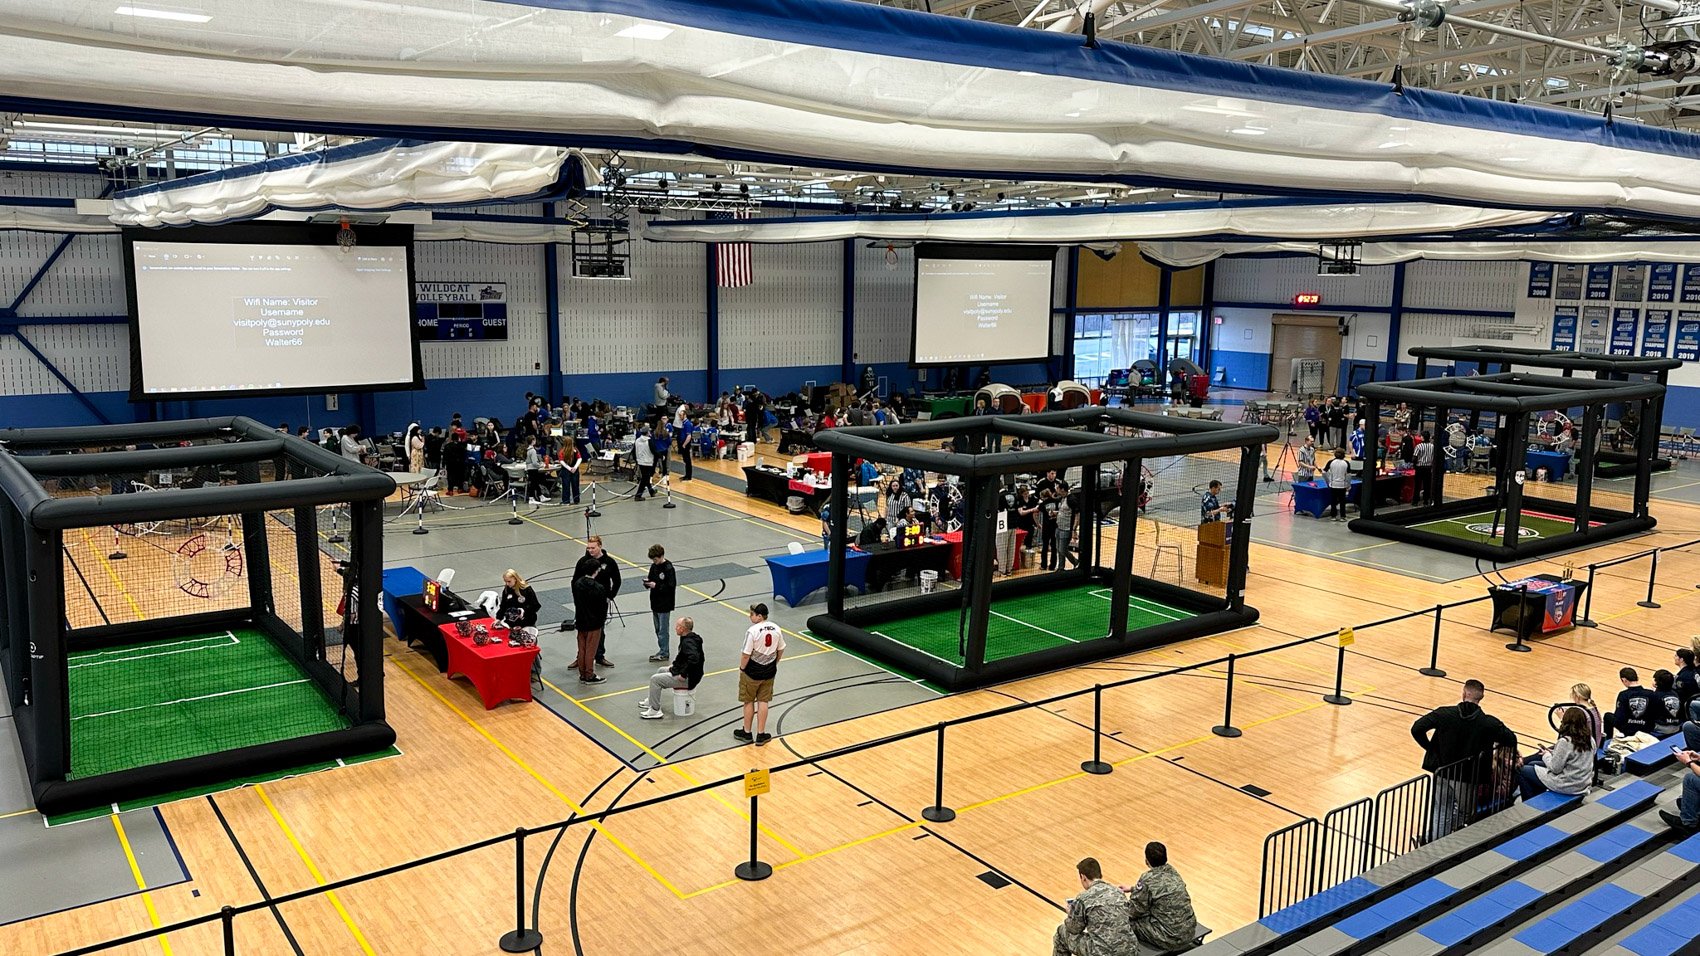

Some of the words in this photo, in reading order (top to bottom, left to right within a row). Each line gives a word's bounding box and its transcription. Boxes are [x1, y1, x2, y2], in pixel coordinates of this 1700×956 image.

[420, 284, 470, 292] WILDCAT
[244, 298, 260, 306] Wifi
[262, 298, 290, 306] Name:
[233, 318, 330, 328] visitpoly@sunypoly.edu
[263, 328, 304, 336] Password
[265, 338, 303, 346] Walter66
[998, 520, 1004, 530] B
